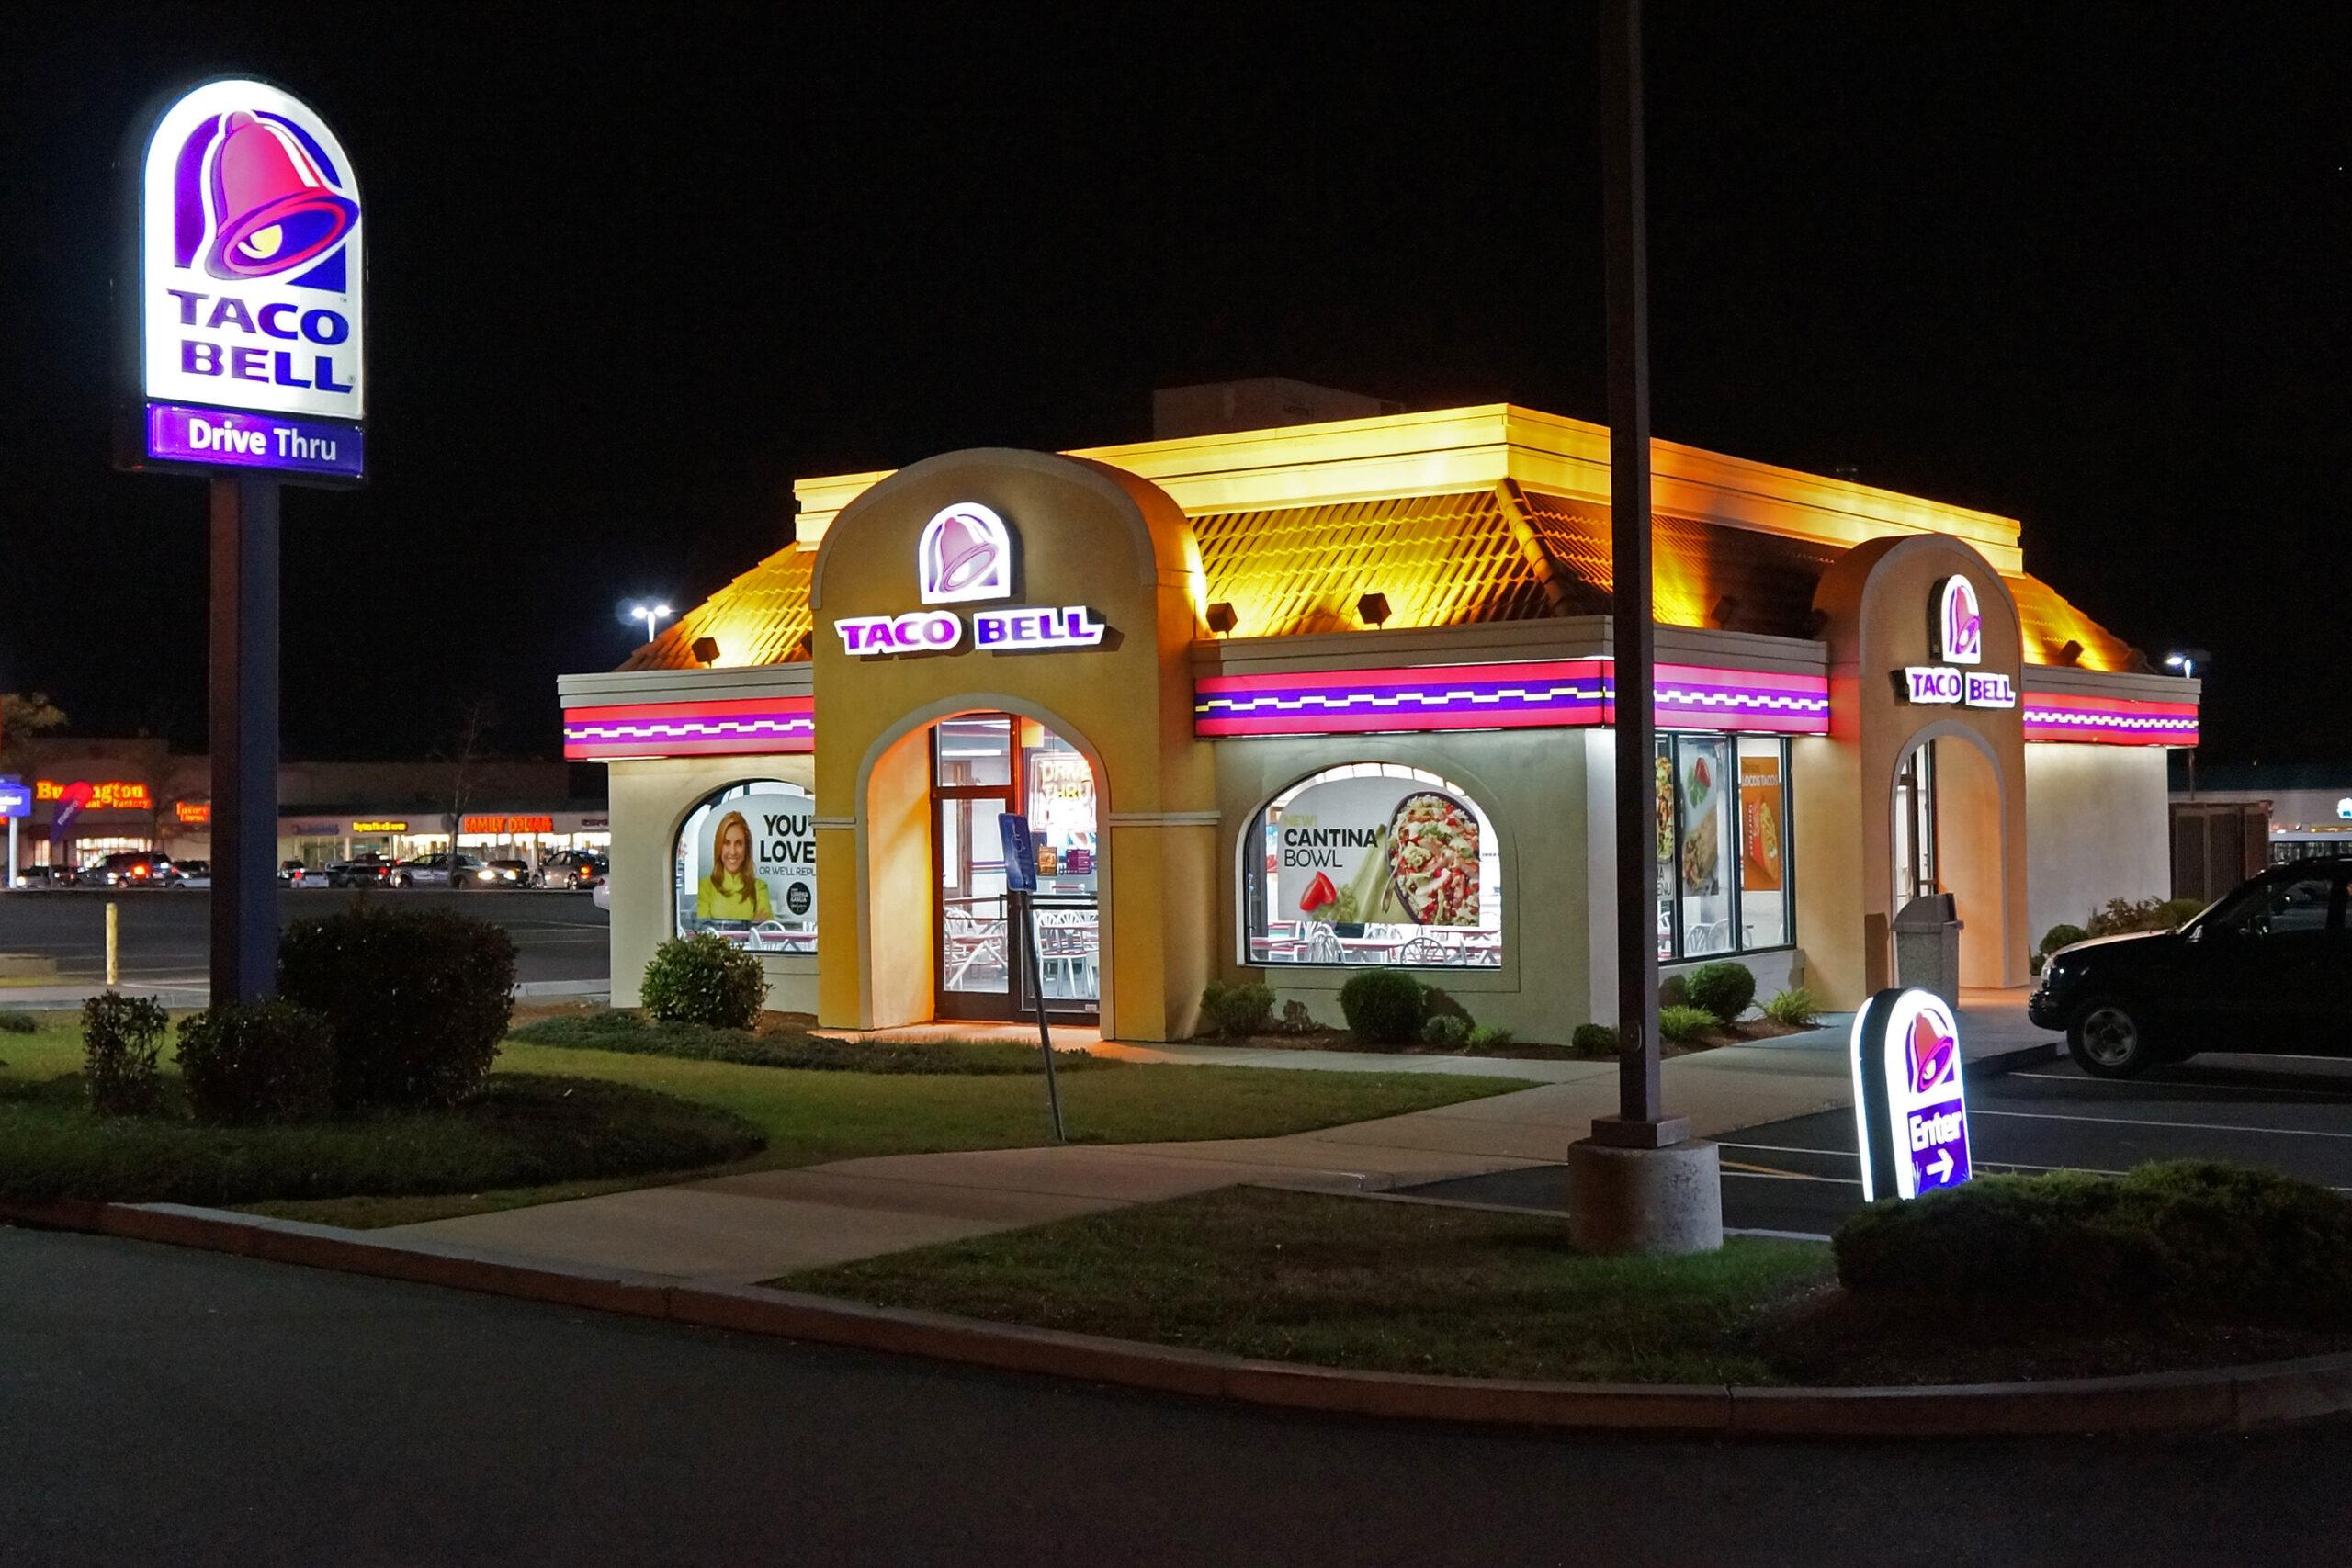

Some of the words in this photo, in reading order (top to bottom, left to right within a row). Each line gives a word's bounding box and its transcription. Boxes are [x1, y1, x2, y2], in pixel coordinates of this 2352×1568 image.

[166, 288, 350, 345] TACO
[181, 339, 355, 394] BELL
[189, 418, 266, 456] Drive
[273, 428, 337, 461] Thru
[840, 618, 956, 650] TACO
[978, 613, 1096, 645] BELL
[1912, 673, 1962, 698] TACO
[1969, 677, 2014, 702] BELL
[36, 782, 144, 803] Bungton
[464, 816, 505, 834] FAMILY
[763, 814, 816, 838] YOU'
[1284, 829, 1379, 848] CANTINA
[760, 840, 817, 863] LOVE
[1284, 849, 1343, 868] BOWL
[759, 866, 771, 875] OR
[1657, 882, 1672, 897] ENU
[1908, 1111, 1962, 1153] Enter
